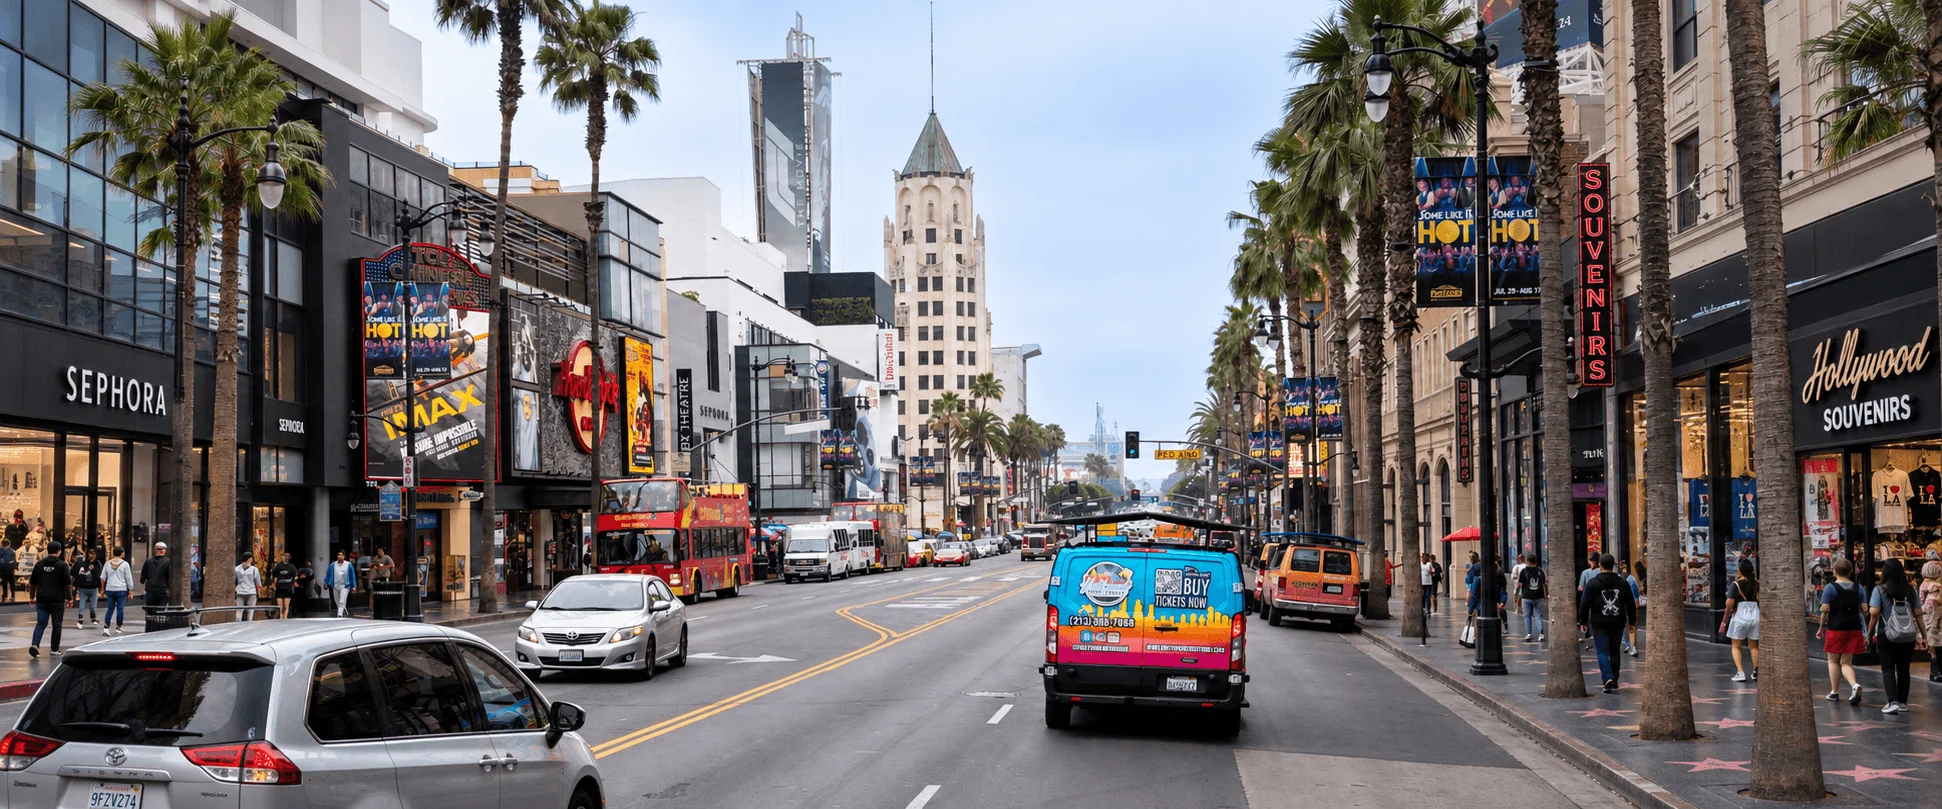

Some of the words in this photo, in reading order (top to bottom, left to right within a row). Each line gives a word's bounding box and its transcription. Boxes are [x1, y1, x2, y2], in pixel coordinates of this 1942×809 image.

[1419, 209, 1443, 220] SOME
[1417, 219, 1474, 244] HOT
[1491, 218, 1539, 243] HOT
[1584, 169, 1606, 381] SOUVENIRS
[365, 323, 402, 339] HOT
[411, 322, 448, 339] HOT
[1802, 326, 1932, 404] Hollywood
[66, 365, 167, 416] SEPHORA
[381, 383, 484, 441] IMAX
[678, 376, 691, 430] THEATRE
[1285, 405, 1310, 417] HOT
[1317, 403, 1342, 415] HOT
[1823, 394, 1912, 432] SOUVENIRS
[1883, 494, 1901, 504] LA
[1183, 577, 1211, 596] BUY
[1156, 596, 1186, 608] TICKETS
[1188, 597, 1208, 609] NOW
[90, 791, 137, 809] 9FZV274
